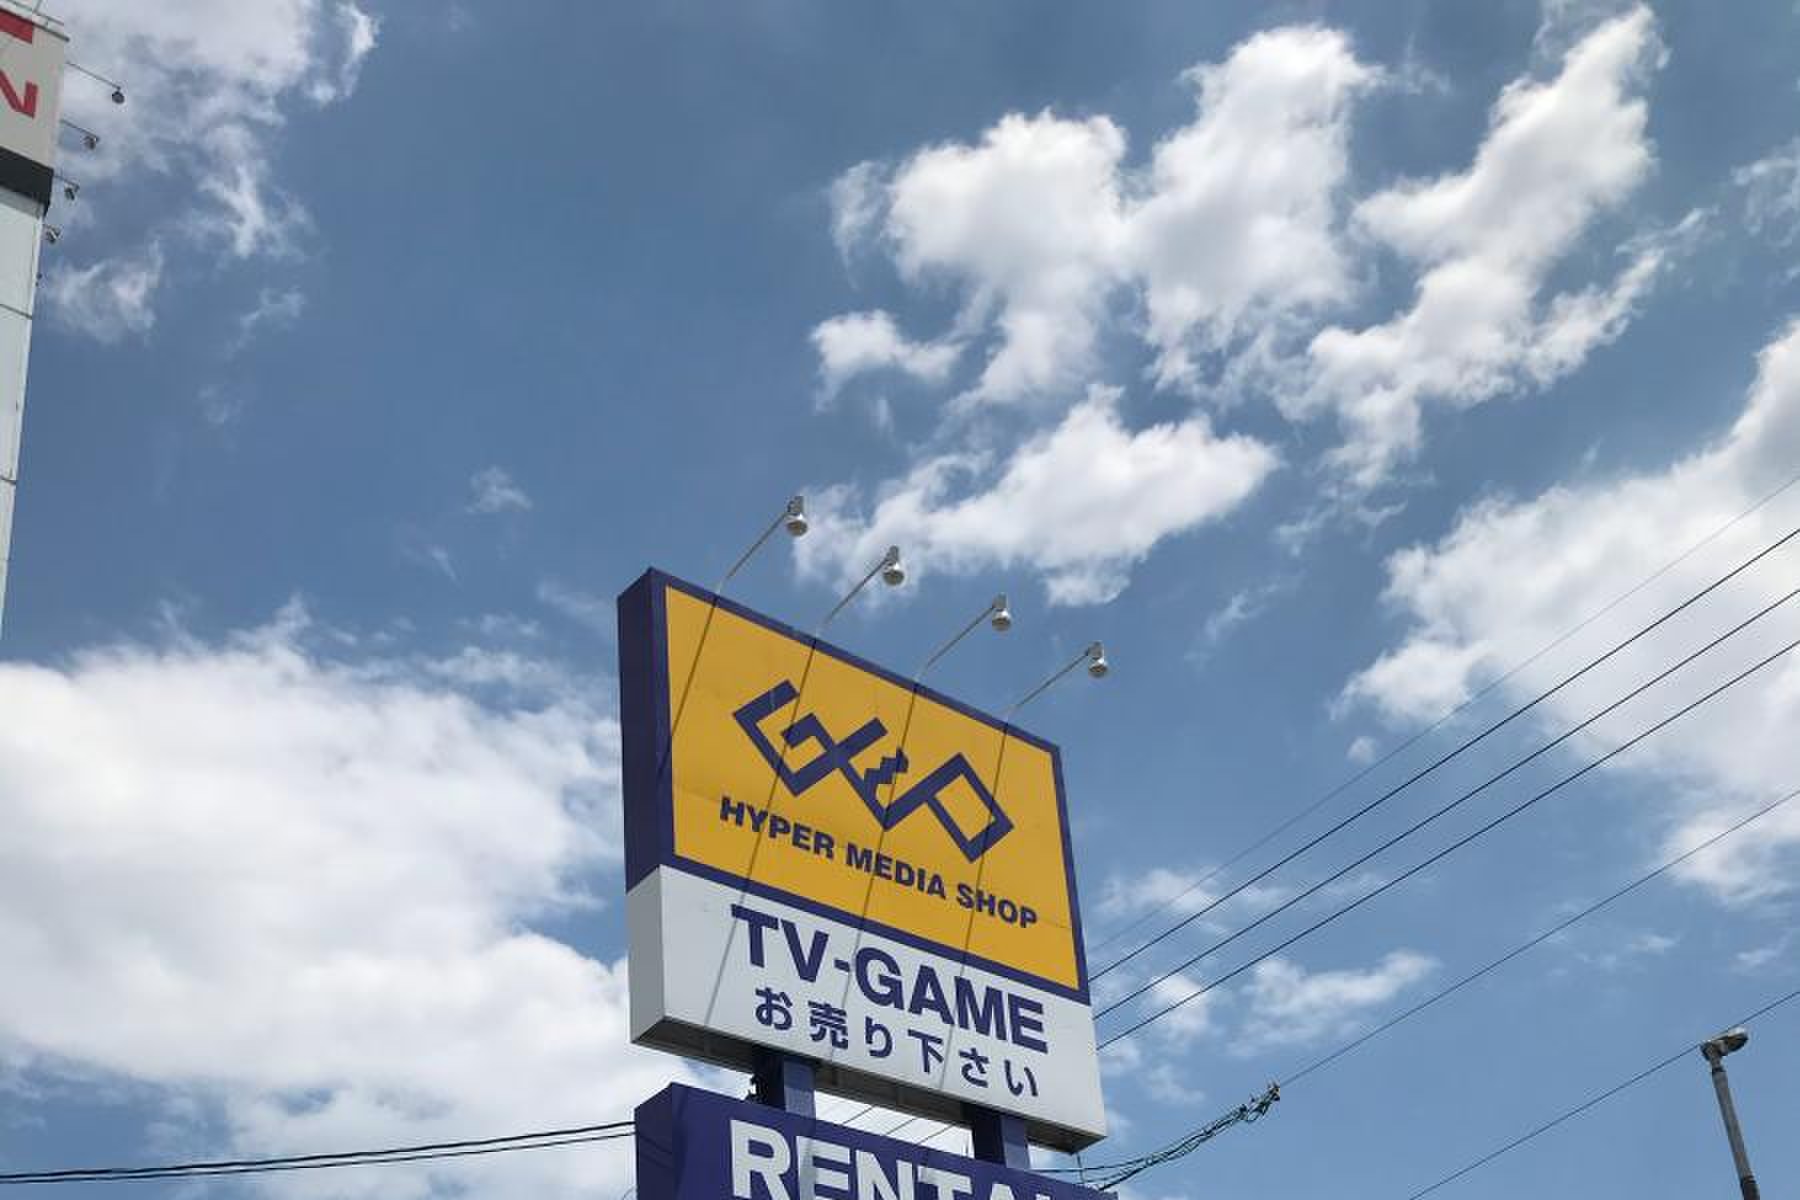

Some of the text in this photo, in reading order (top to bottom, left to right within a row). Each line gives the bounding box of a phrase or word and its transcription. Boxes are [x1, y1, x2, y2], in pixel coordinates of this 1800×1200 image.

[720, 796, 1038, 929] HYPER MEDIA SHOP
[731, 904, 1048, 1053] TV-GAME
[755, 986, 1040, 1098] お売り下さい
